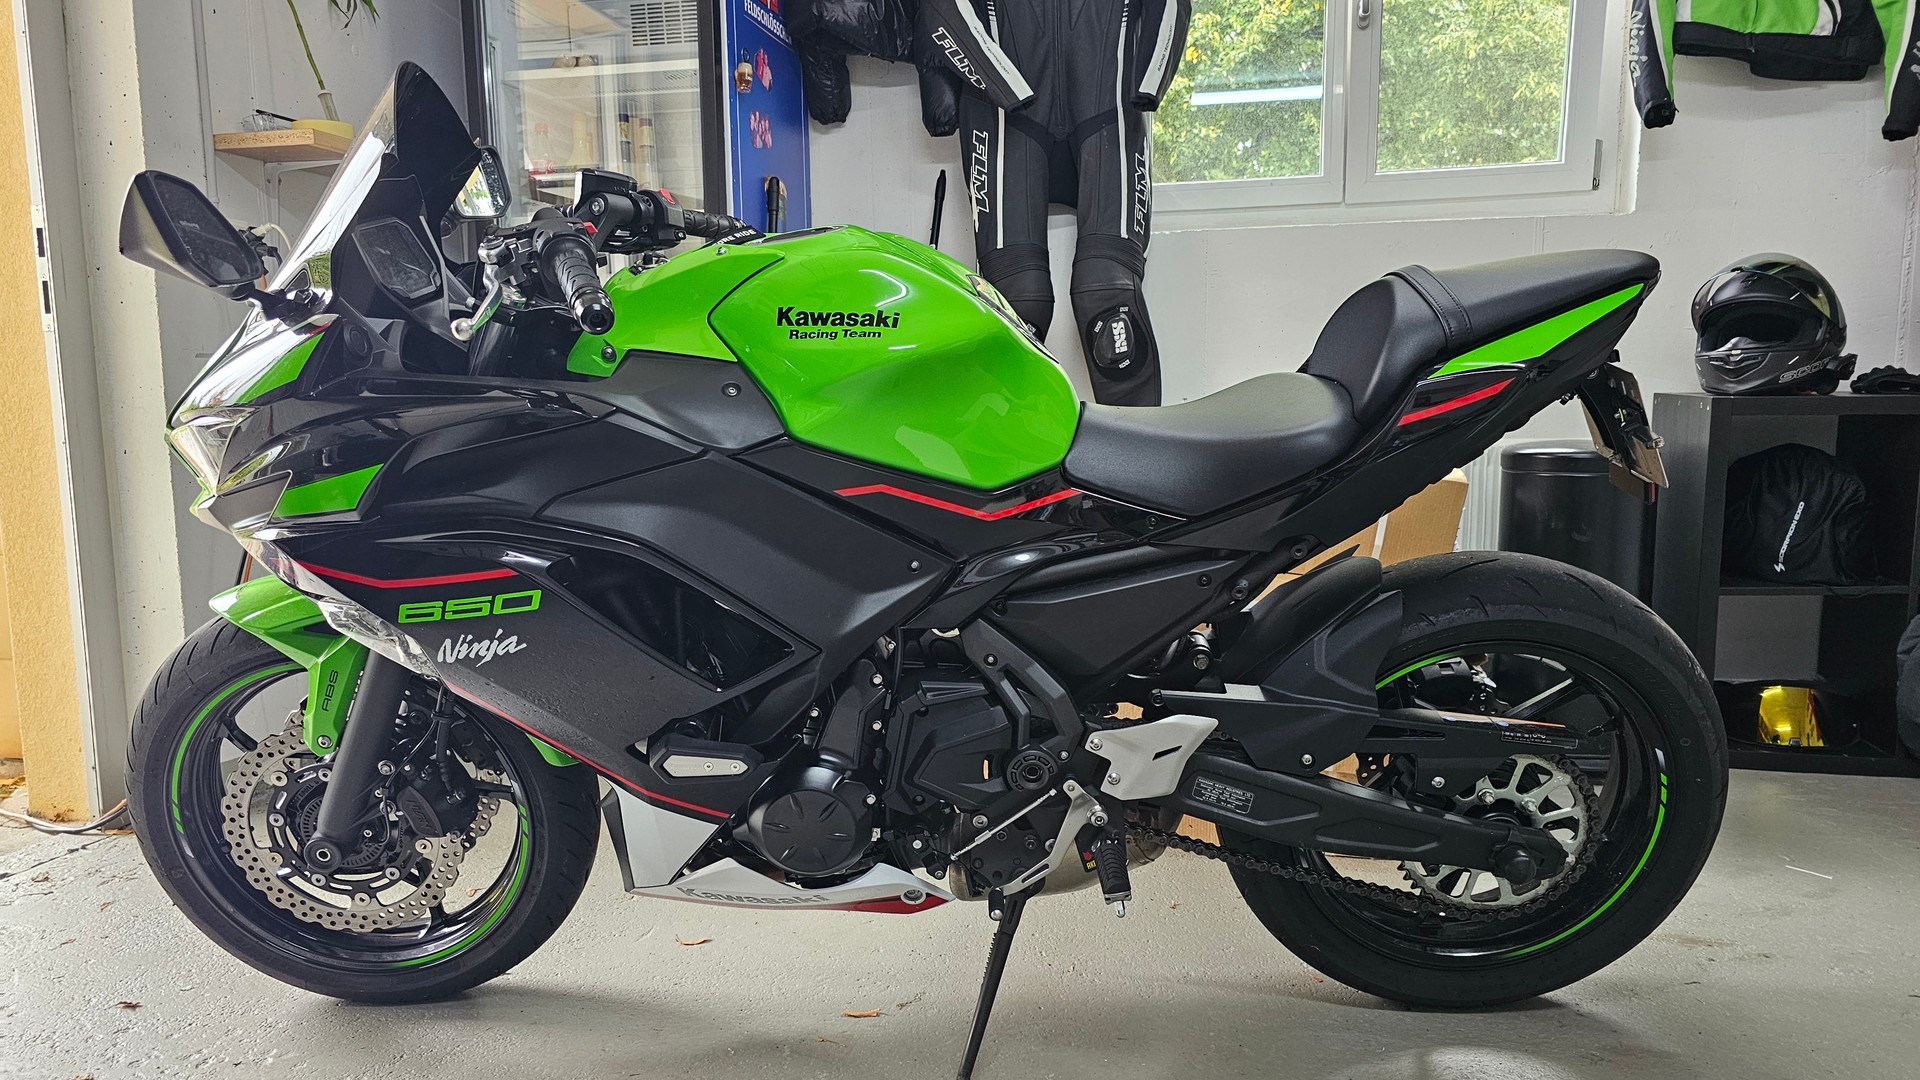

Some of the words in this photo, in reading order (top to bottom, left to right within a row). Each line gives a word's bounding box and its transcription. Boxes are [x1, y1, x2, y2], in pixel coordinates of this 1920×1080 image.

[931, 26, 986, 90] FLM
[733, 229, 757, 239] RIDE
[776, 306, 900, 329] Kawasaki
[788, 329, 838, 340] Racing
[842, 329, 882, 338] Team
[1779, 520, 1797, 563] SCORPION
[1794, 501, 1805, 520] EXO
[398, 589, 542, 624] 650
[437, 628, 527, 668] Ninja
[321, 669, 338, 712] ABS
[676, 886, 830, 905] Kawasaki
